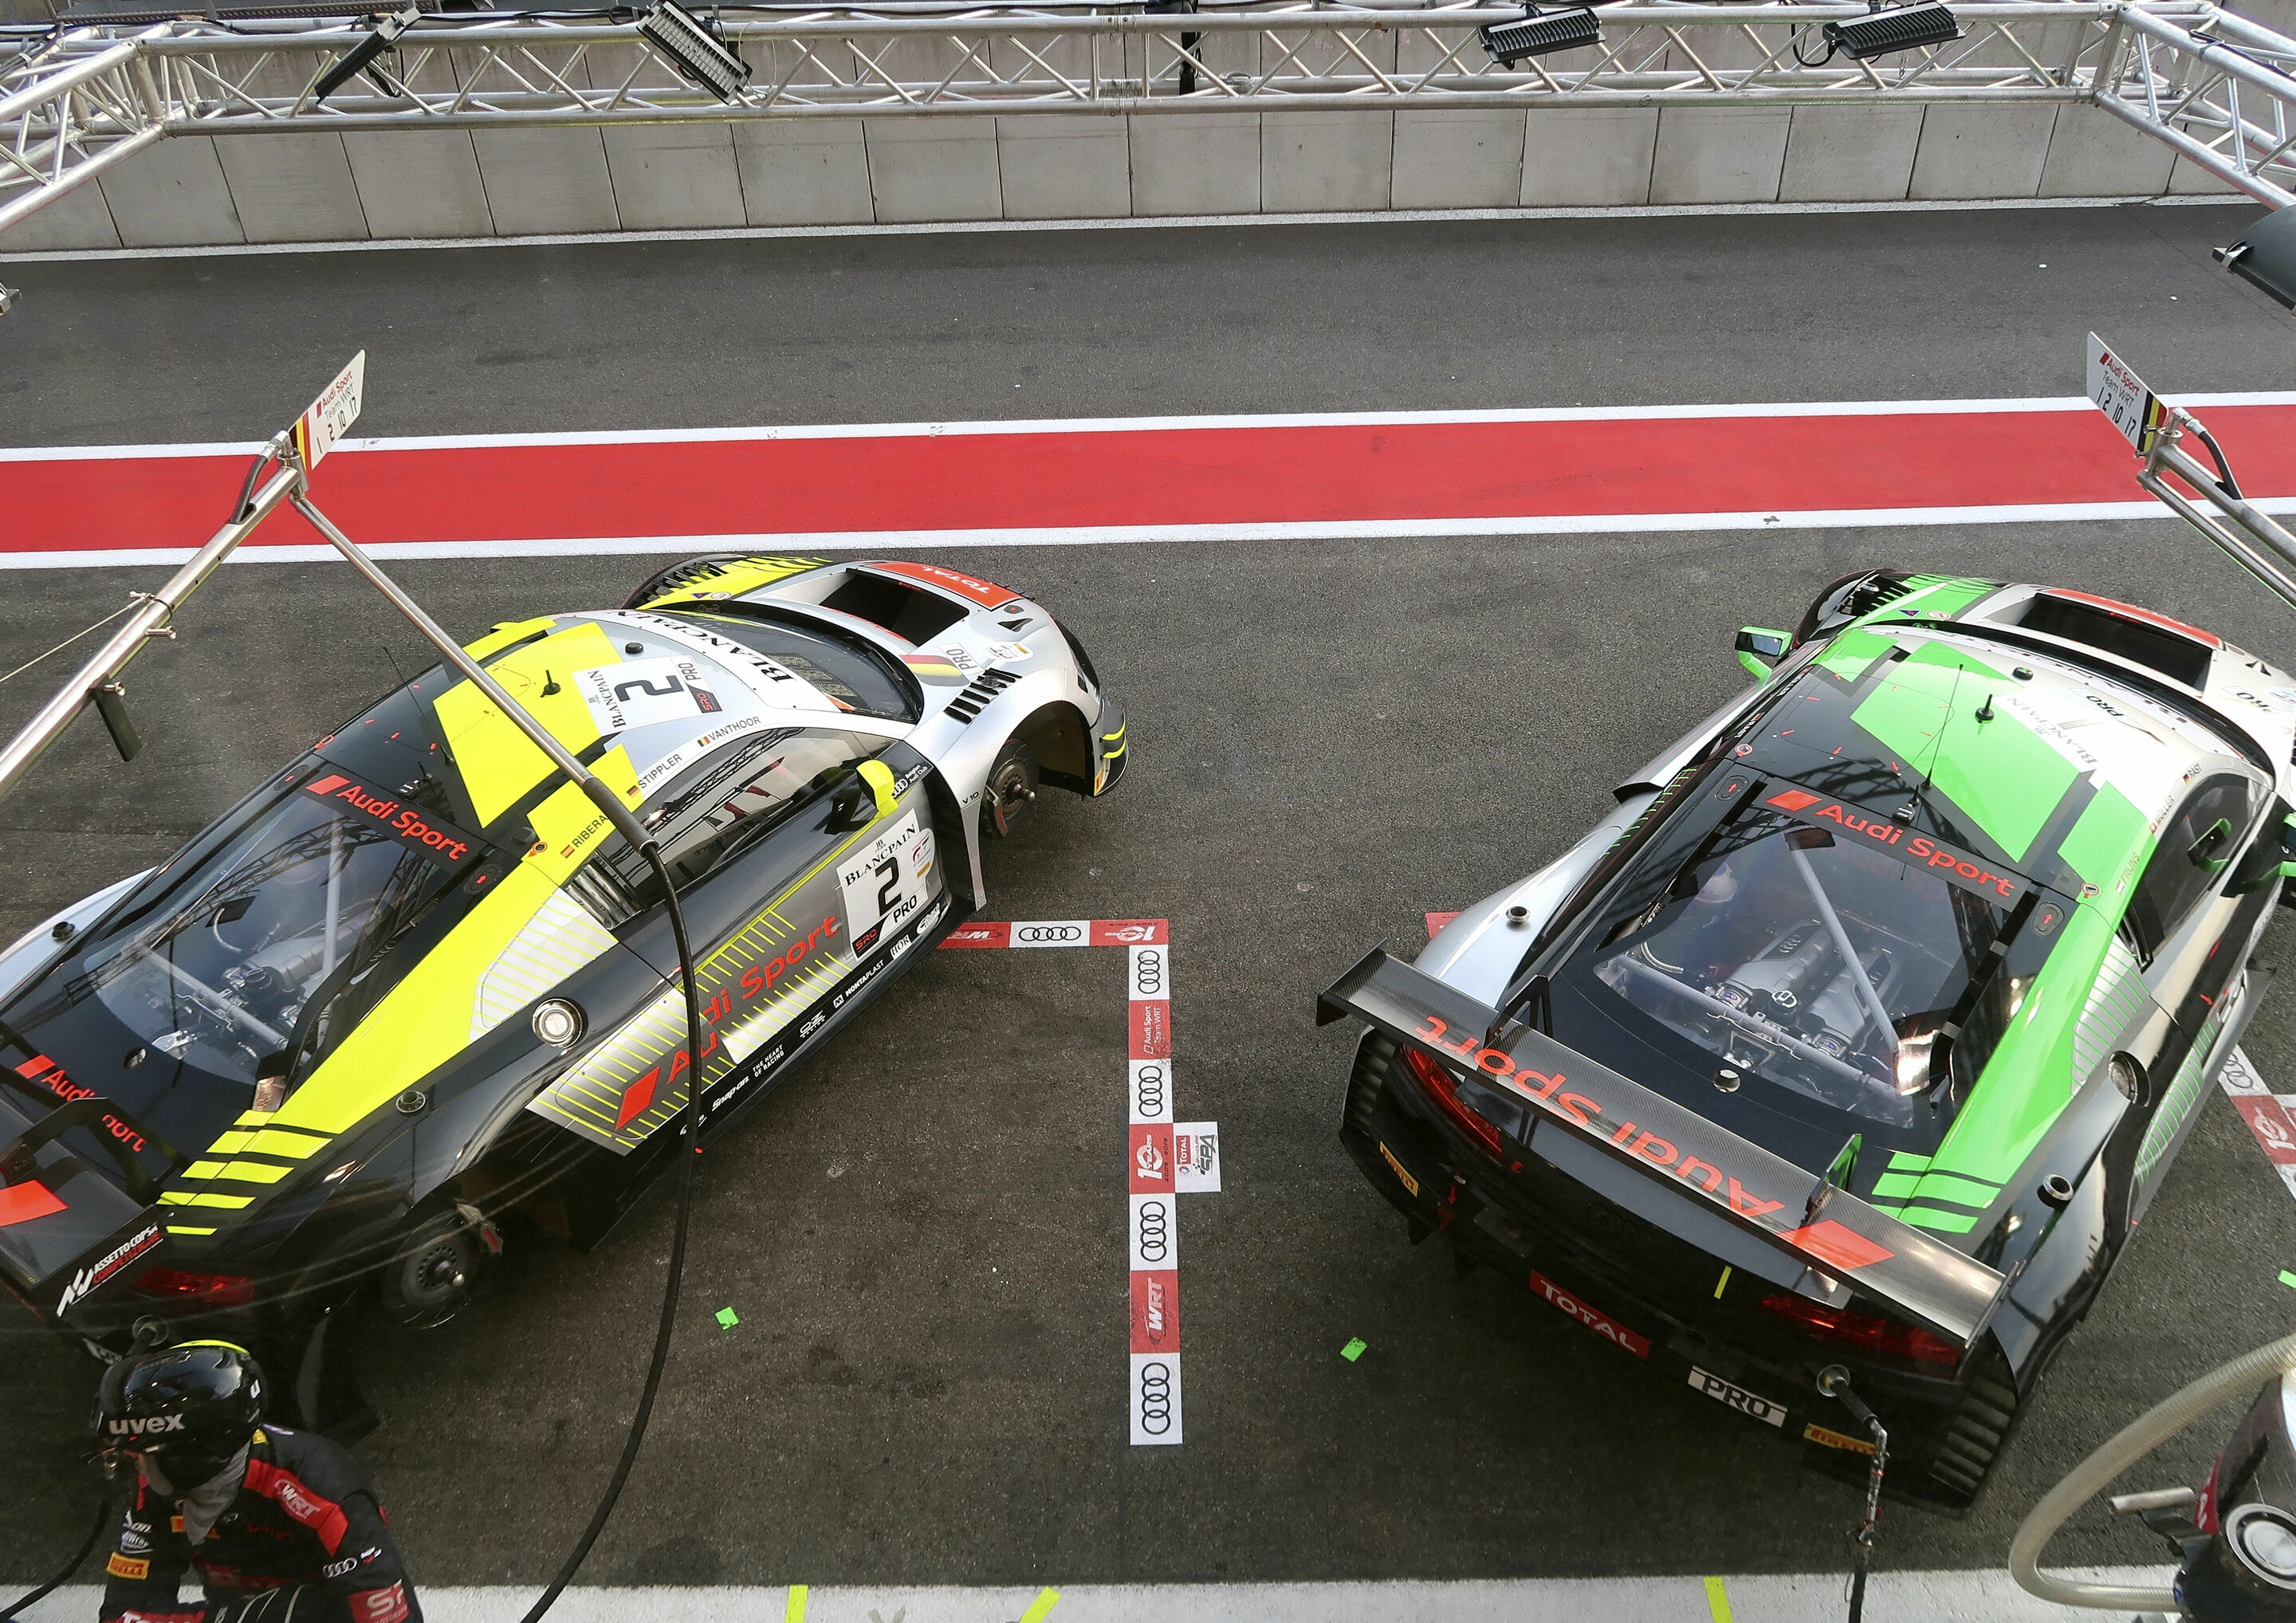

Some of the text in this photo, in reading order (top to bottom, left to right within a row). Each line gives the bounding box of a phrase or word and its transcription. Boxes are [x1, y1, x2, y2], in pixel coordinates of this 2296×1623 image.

[322, 371, 353, 409] Audi Sport
[2102, 371, 2135, 408] Team WRT
[2106, 358, 2141, 397] Audi Sport
[324, 383, 354, 421] Team WRT
[2097, 387, 2137, 438] 1 2 10 17
[316, 396, 358, 454] 1 2 10 17
[922, 567, 990, 594] TOTAL
[678, 662, 702, 682] PRO
[946, 648, 978, 670] PRO
[588, 670, 627, 729] BLANCPAIN
[614, 675, 685, 702] 2
[697, 693, 714, 711] SRO
[2086, 695, 2124, 717] PRO
[709, 716, 761, 741] VANTHOOR
[2007, 697, 2098, 765] BLANCPAIN
[638, 753, 683, 789] STIPPLER
[905, 763, 922, 779] Belgian
[909, 765, 928, 784] Audi Club
[2188, 763, 2202, 778] RAST
[336, 784, 468, 860] Audi Sport
[572, 814, 610, 848] RIBERA
[844, 823, 918, 888] BLANCPAIN
[1815, 804, 1905, 845] Audi
[1907, 836, 2015, 898] Sport
[875, 856, 902, 918] 2
[893, 894, 918, 924] PRO
[855, 928, 877, 950] SRO
[741, 916, 839, 1000] Sport
[845, 959, 885, 997] MONTAPLAST
[1143, 1004, 1153, 1045] Audi Sport
[752, 1043, 783, 1073] THE HEART
[754, 1050, 785, 1078] OF RACING
[1414, 1015, 1602, 1127] Sport
[1136, 1144, 1163, 1180] 10
[1199, 1134, 1217, 1172] SPA
[94, 1241, 131, 1275] ASSETTO
[1147, 1277, 1164, 1331] WRT
[1540, 1279, 1637, 1353] TOTAL
[1702, 1374, 1771, 1420] PRO
[108, 1413, 185, 1435] uvex
[281, 1483, 321, 1515] WRT
